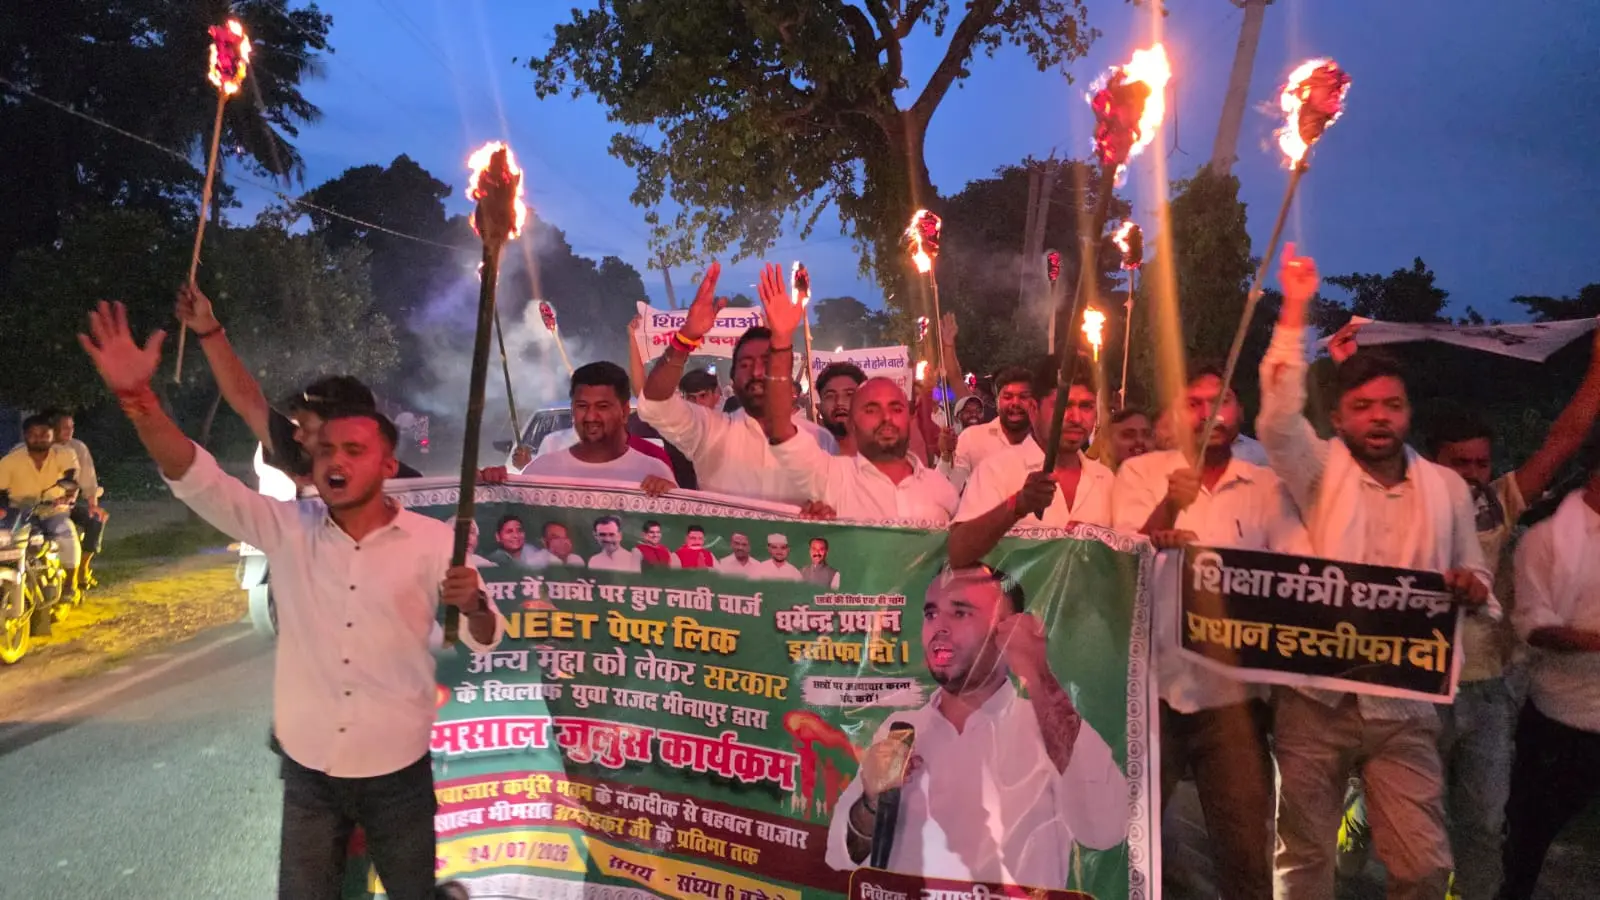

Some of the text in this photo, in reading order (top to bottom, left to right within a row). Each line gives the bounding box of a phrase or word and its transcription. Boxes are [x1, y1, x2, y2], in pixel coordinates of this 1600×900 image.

[715, 312, 761, 328] चाओ
[520, 576, 544, 599] में
[546, 578, 596, 601] छात्रों
[598, 585, 627, 603] पर
[630, 586, 663, 611] हुए
[665, 587, 715, 612] लाठी
[718, 592, 763, 617] चार्ज
[1192, 552, 1273, 598] शिक्षा
[1277, 563, 1347, 607] मंत्री
[503, 610, 741, 653] NEET पेपर लिक
[1188, 611, 1450, 672] प्रधान इस्तीफा दो
[467, 651, 529, 673] अन्य
[592, 646, 627, 677] को
[634, 650, 696, 686] लेकर
[703, 664, 789, 700] सरकार
[454, 681, 479, 704] के
[482, 680, 563, 702] खिलाफ
[570, 684, 609, 709] युवा
[612, 687, 660, 711] राजद
[731, 706, 769, 729] द्वारा
[430, 716, 551, 755] मसाल
[595, 783, 613, 804] के
[616, 790, 680, 819] नजदीक
[682, 799, 699, 823] से
[756, 820, 809, 849] बाजार
[628, 816, 653, 841] जी
[655, 820, 674, 845] के
[676, 828, 728, 858] प्रतिमा
[730, 845, 760, 866] तक
[609, 854, 656, 882] समय
